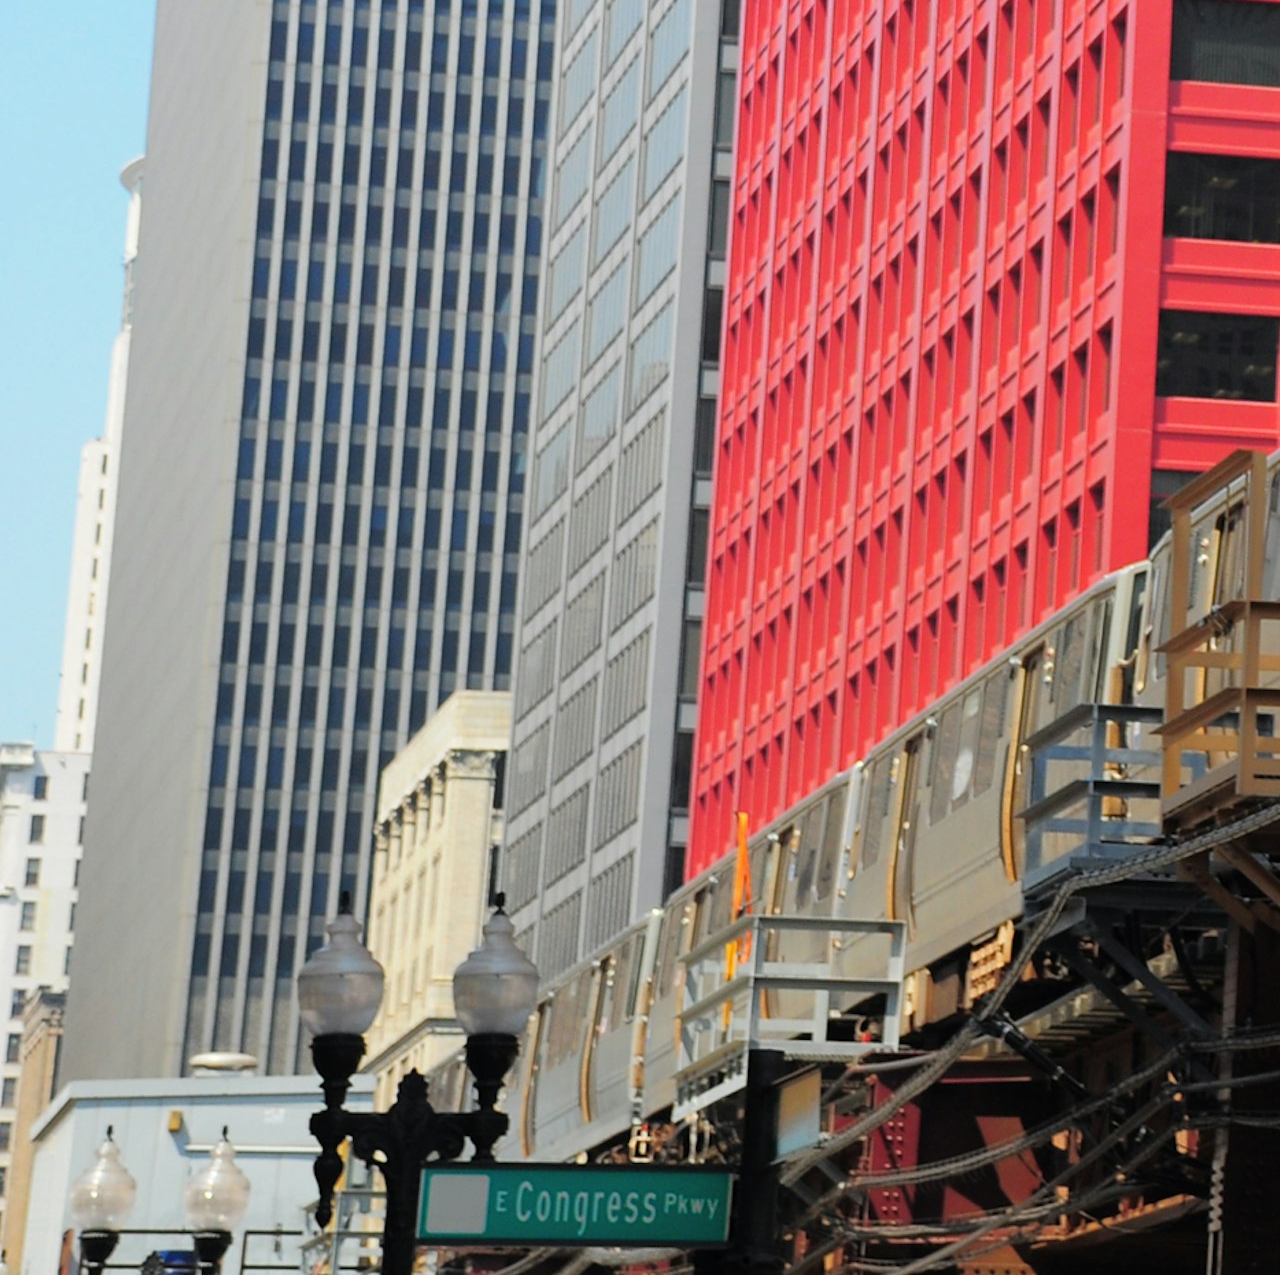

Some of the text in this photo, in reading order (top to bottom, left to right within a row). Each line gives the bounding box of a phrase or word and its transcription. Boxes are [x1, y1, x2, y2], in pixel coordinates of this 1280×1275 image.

[496, 1181, 719, 1236] E Congress Pkwy
